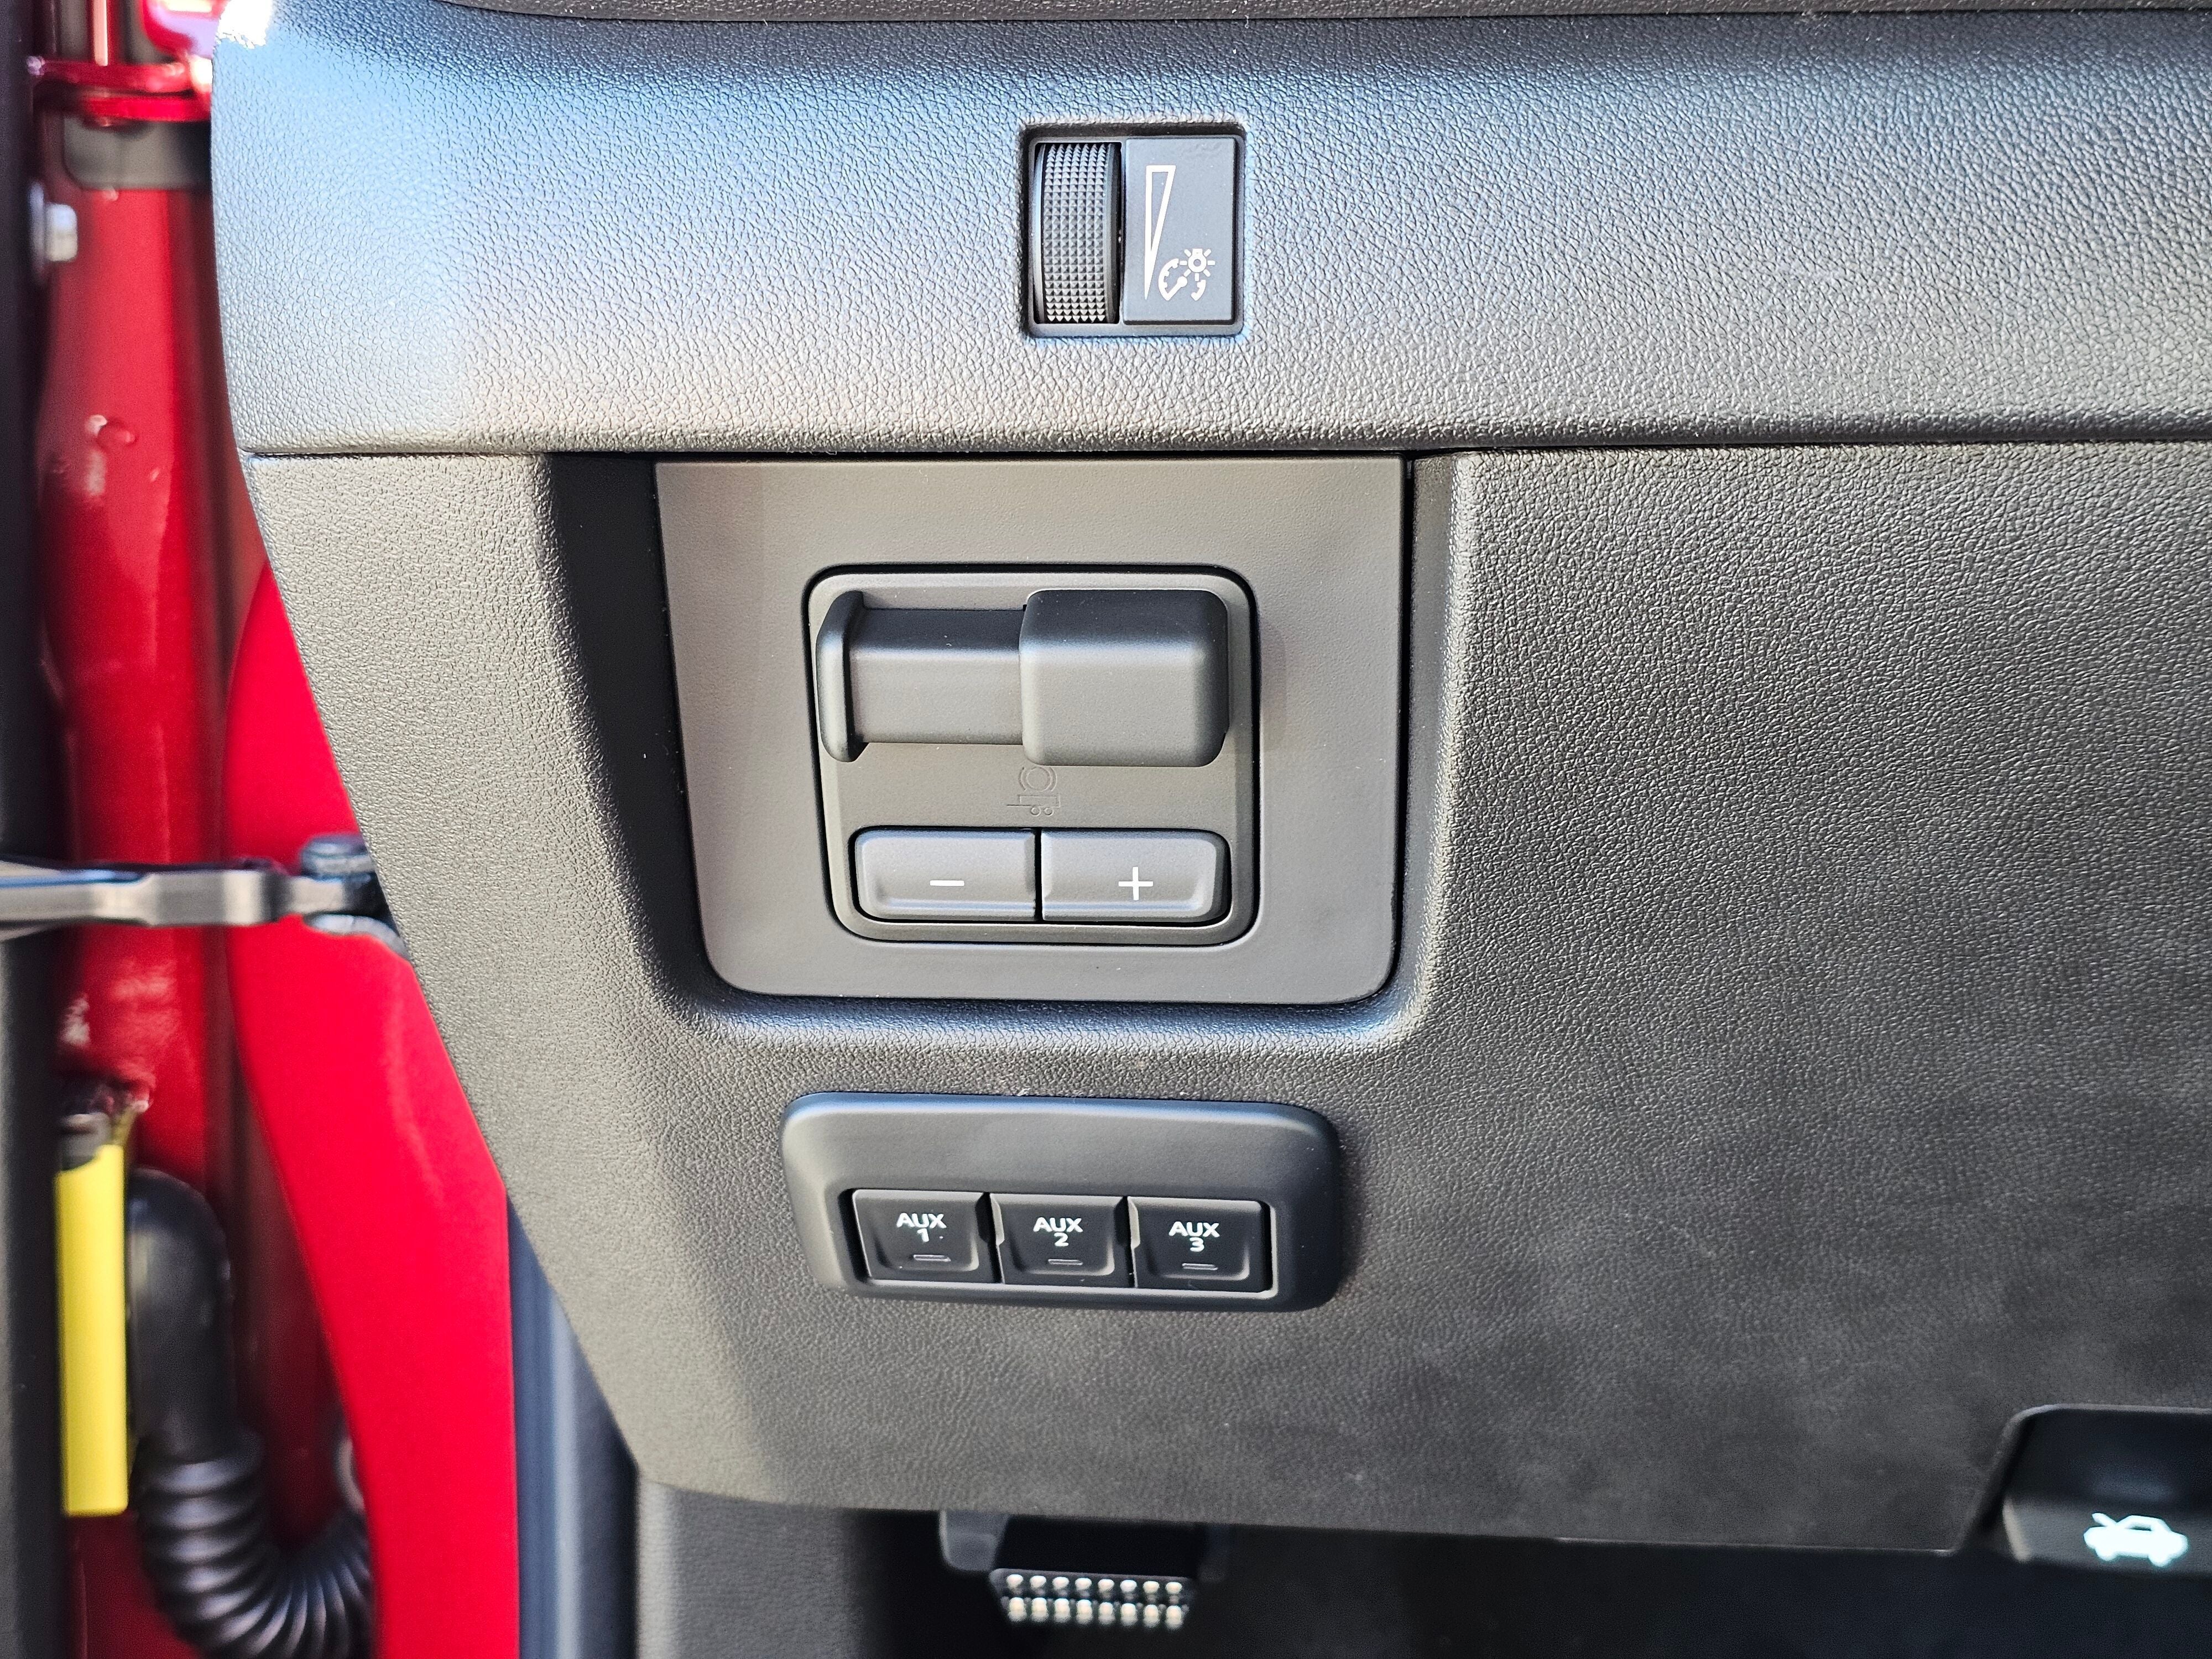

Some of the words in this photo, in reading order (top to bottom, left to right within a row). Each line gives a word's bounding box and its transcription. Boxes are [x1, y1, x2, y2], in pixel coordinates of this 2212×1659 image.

[896, 1212, 947, 1229] AUX
[1032, 1217, 1083, 1233] AUX
[916, 1228, 930, 1243] 1
[1168, 1221, 1220, 1238] AUX
[1053, 1233, 1069, 1247] 2
[1189, 1237, 1204, 1253] 3
